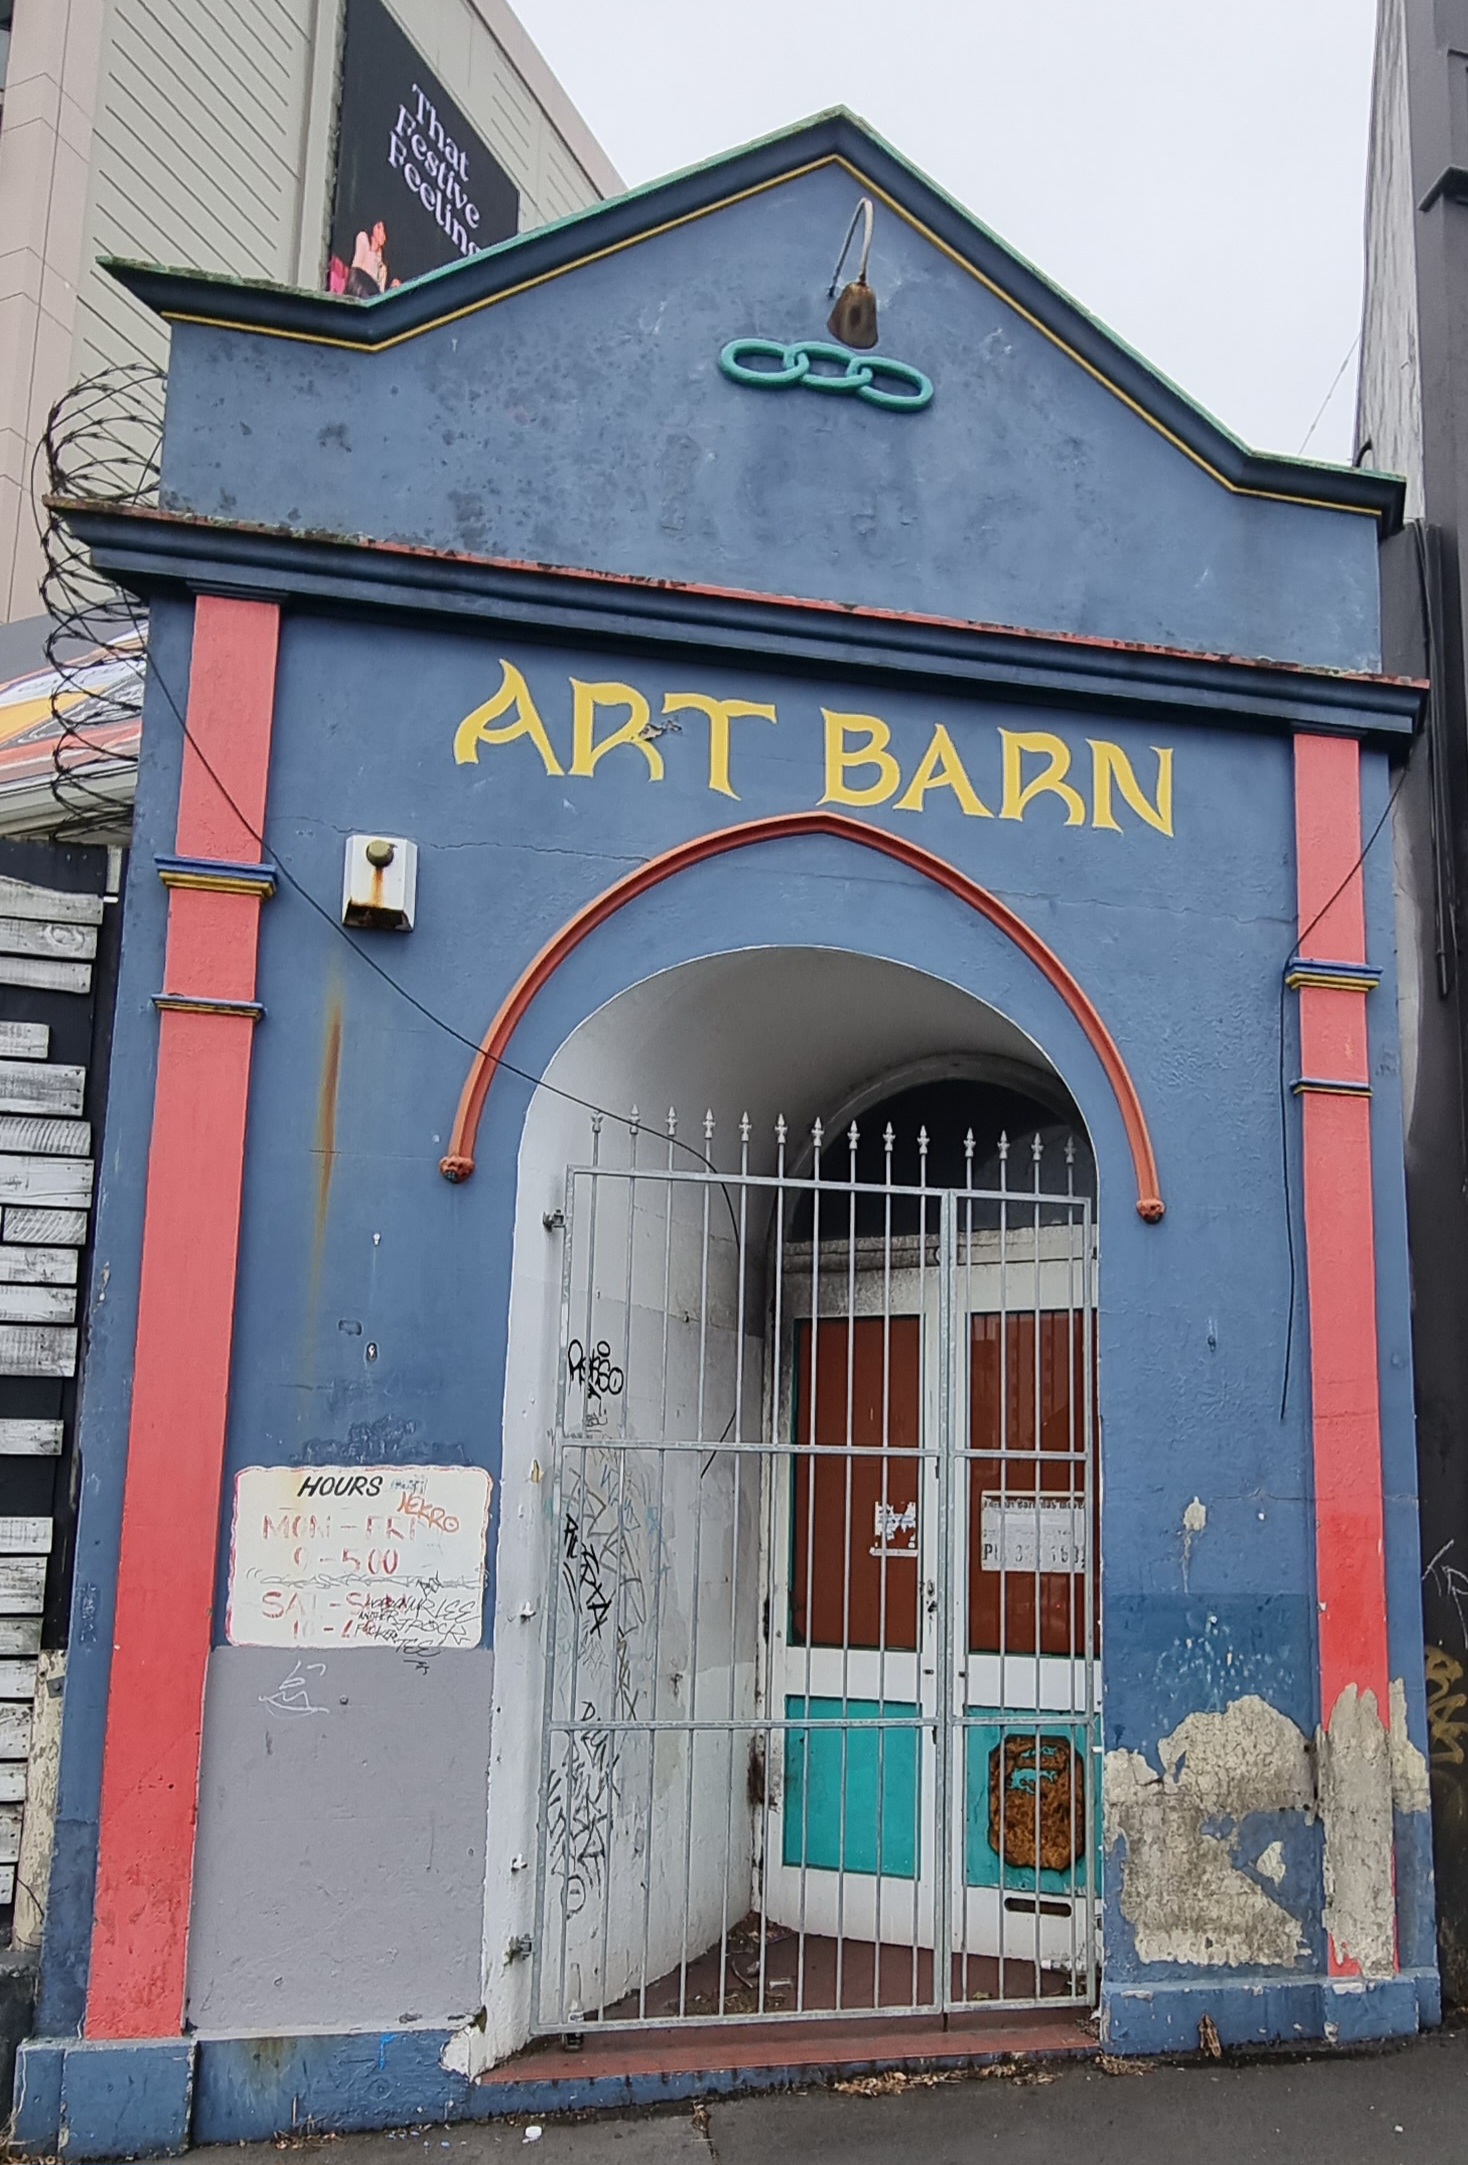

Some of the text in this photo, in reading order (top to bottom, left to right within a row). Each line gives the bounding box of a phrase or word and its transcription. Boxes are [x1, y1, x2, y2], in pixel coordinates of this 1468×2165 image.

[395, 104, 480, 228] Festive
[412, 83, 469, 181] That
[453, 659, 1174, 837] ART BARN
[297, 1476, 383, 1497] HOURS
